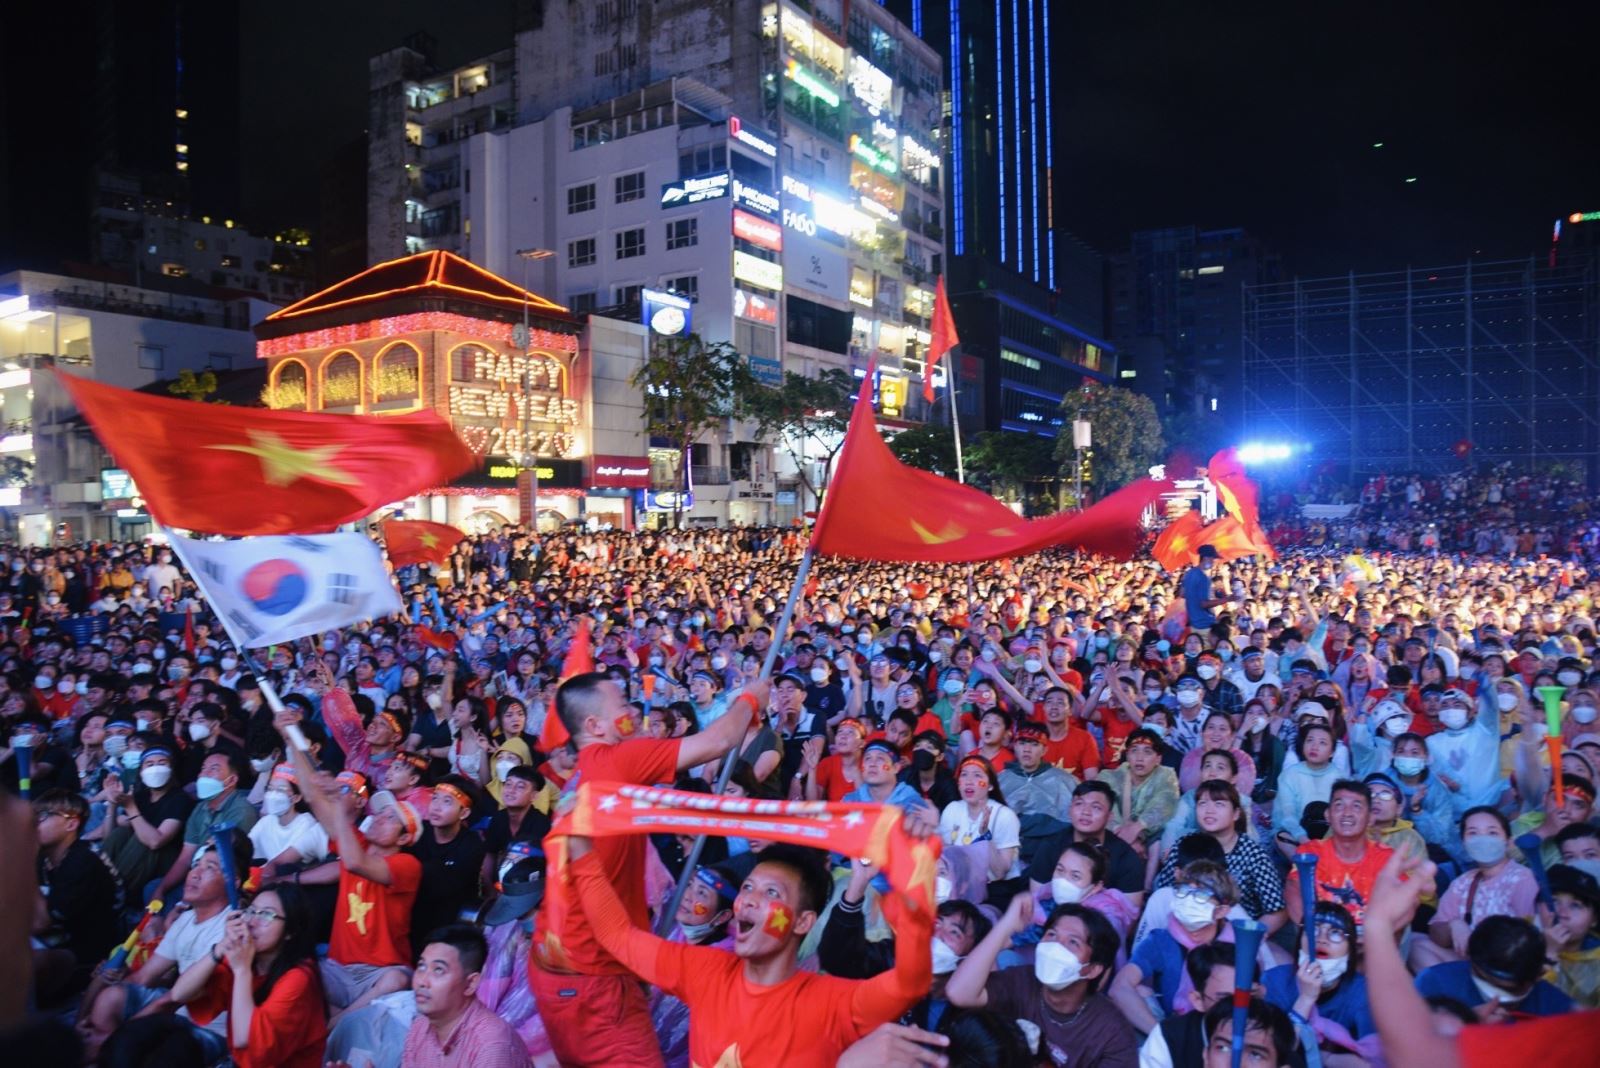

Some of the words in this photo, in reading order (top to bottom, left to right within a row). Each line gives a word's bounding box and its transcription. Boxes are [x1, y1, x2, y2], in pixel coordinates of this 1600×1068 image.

[474, 351, 560, 388] HAPPY
[450, 387, 509, 417] NEW
[512, 392, 578, 425] YEAR
[490, 427, 551, 456] 2022
